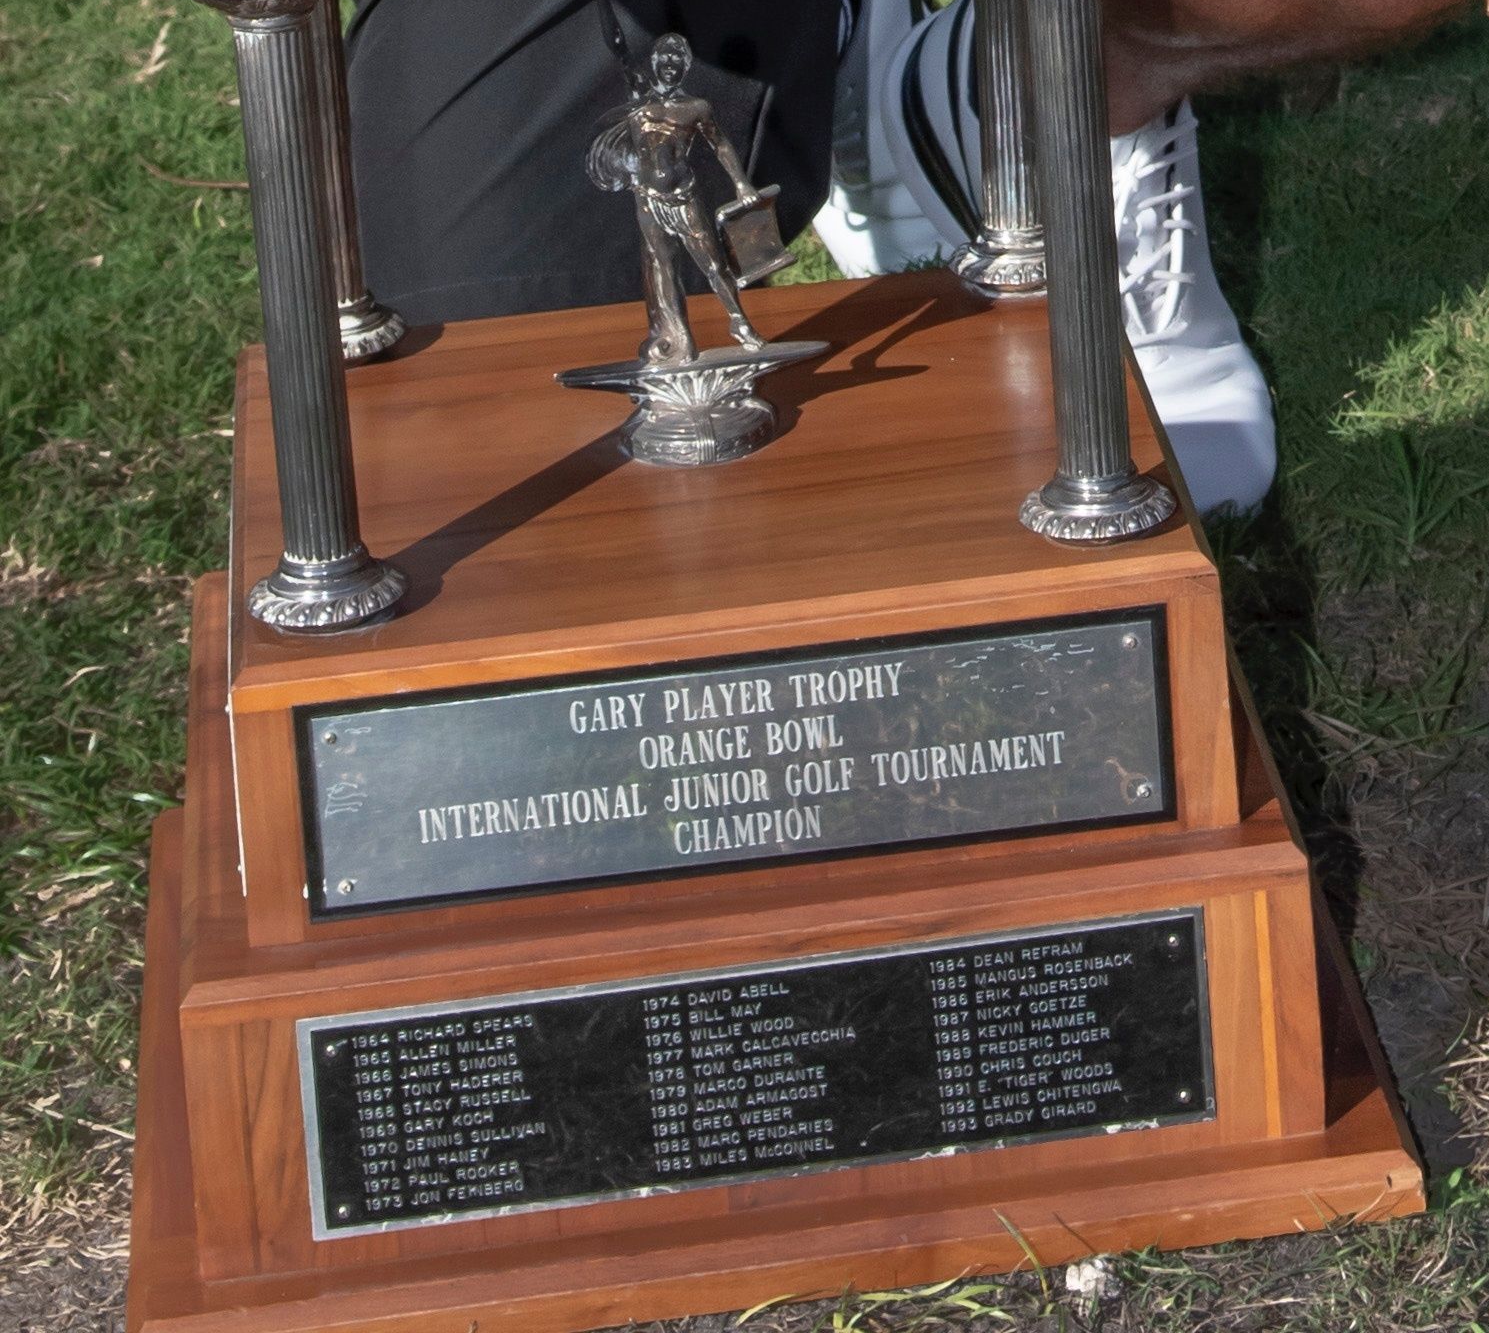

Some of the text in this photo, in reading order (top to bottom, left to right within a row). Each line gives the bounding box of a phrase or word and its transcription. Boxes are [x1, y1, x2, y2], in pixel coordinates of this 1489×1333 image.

[569, 662, 902, 734] GARY PLAYER TROPHY
[639, 715, 843, 769] ORANGE BOWL
[419, 731, 1064, 844] INTERNATIONAL JUNIOR GOLF TOURNAMENT
[674, 805, 821, 854] CHAMPION
[929, 942, 1082, 972] 1984 DEAN REFRAM
[931, 953, 1133, 990] 1985 MANGUS ROSENBACK
[643, 981, 789, 1011] 1974 DAVID ABELL
[932, 974, 1108, 1008] 1986 ERIK ANDERSSON
[644, 1003, 761, 1029] 1975 BILL MAY
[933, 995, 1086, 1026] 1987 NICKY GOETZE
[352, 1014, 532, 1049] 1964 RICHARD SPEARS
[645, 1016, 793, 1047] 1976 WILLIE WOOD
[934, 1012, 1096, 1043] 1988 KEVIN HAMMER
[936, 1027, 1110, 1061] 1989 FREDERIC DUGER
[353, 1034, 515, 1067] 1965 ALLEN MILLER
[647, 1026, 855, 1064] 1977 MARK CALCAVECCHIA
[355, 1052, 516, 1085] 1966 JAMES SIMONS
[648, 1052, 793, 1082] 1978 TOM GARNER
[937, 1050, 1081, 1079] 1990 CHRIS COUCH
[938, 1082, 970, 1096] 1991
[978, 1080, 991, 1091] E.
[1061, 1063, 1113, 1080] WOODS
[356, 1070, 522, 1103] 1967 TONY HADERER
[650, 1066, 825, 1100] 1979 MARCO DURANTE
[940, 1079, 1122, 1114] 1992 LEWIS CHITENGWA
[358, 1087, 530, 1121] 1968 STACY RUSSELL
[651, 1084, 827, 1118] 1980 ADAM ARMAGOST
[941, 1101, 1096, 1132] 1993 GRADY GIRARD
[359, 1110, 493, 1138] 1969 GARY KOCH
[652, 1107, 792, 1136] 1981 GREG WEBER
[654, 1119, 832, 1153] 1982 MARC PENDARIES
[361, 1121, 545, 1157] 1970 DENNIS SULLIVAN
[655, 1137, 834, 1172] 1983 MILES McCONNEL
[363, 1147, 488, 1174] 1971 JIM HANEY
[364, 1161, 519, 1192] 1972 PAUL ROOKER
[366, 1195, 402, 1211] 1973
[411, 1190, 439, 1205] JON
